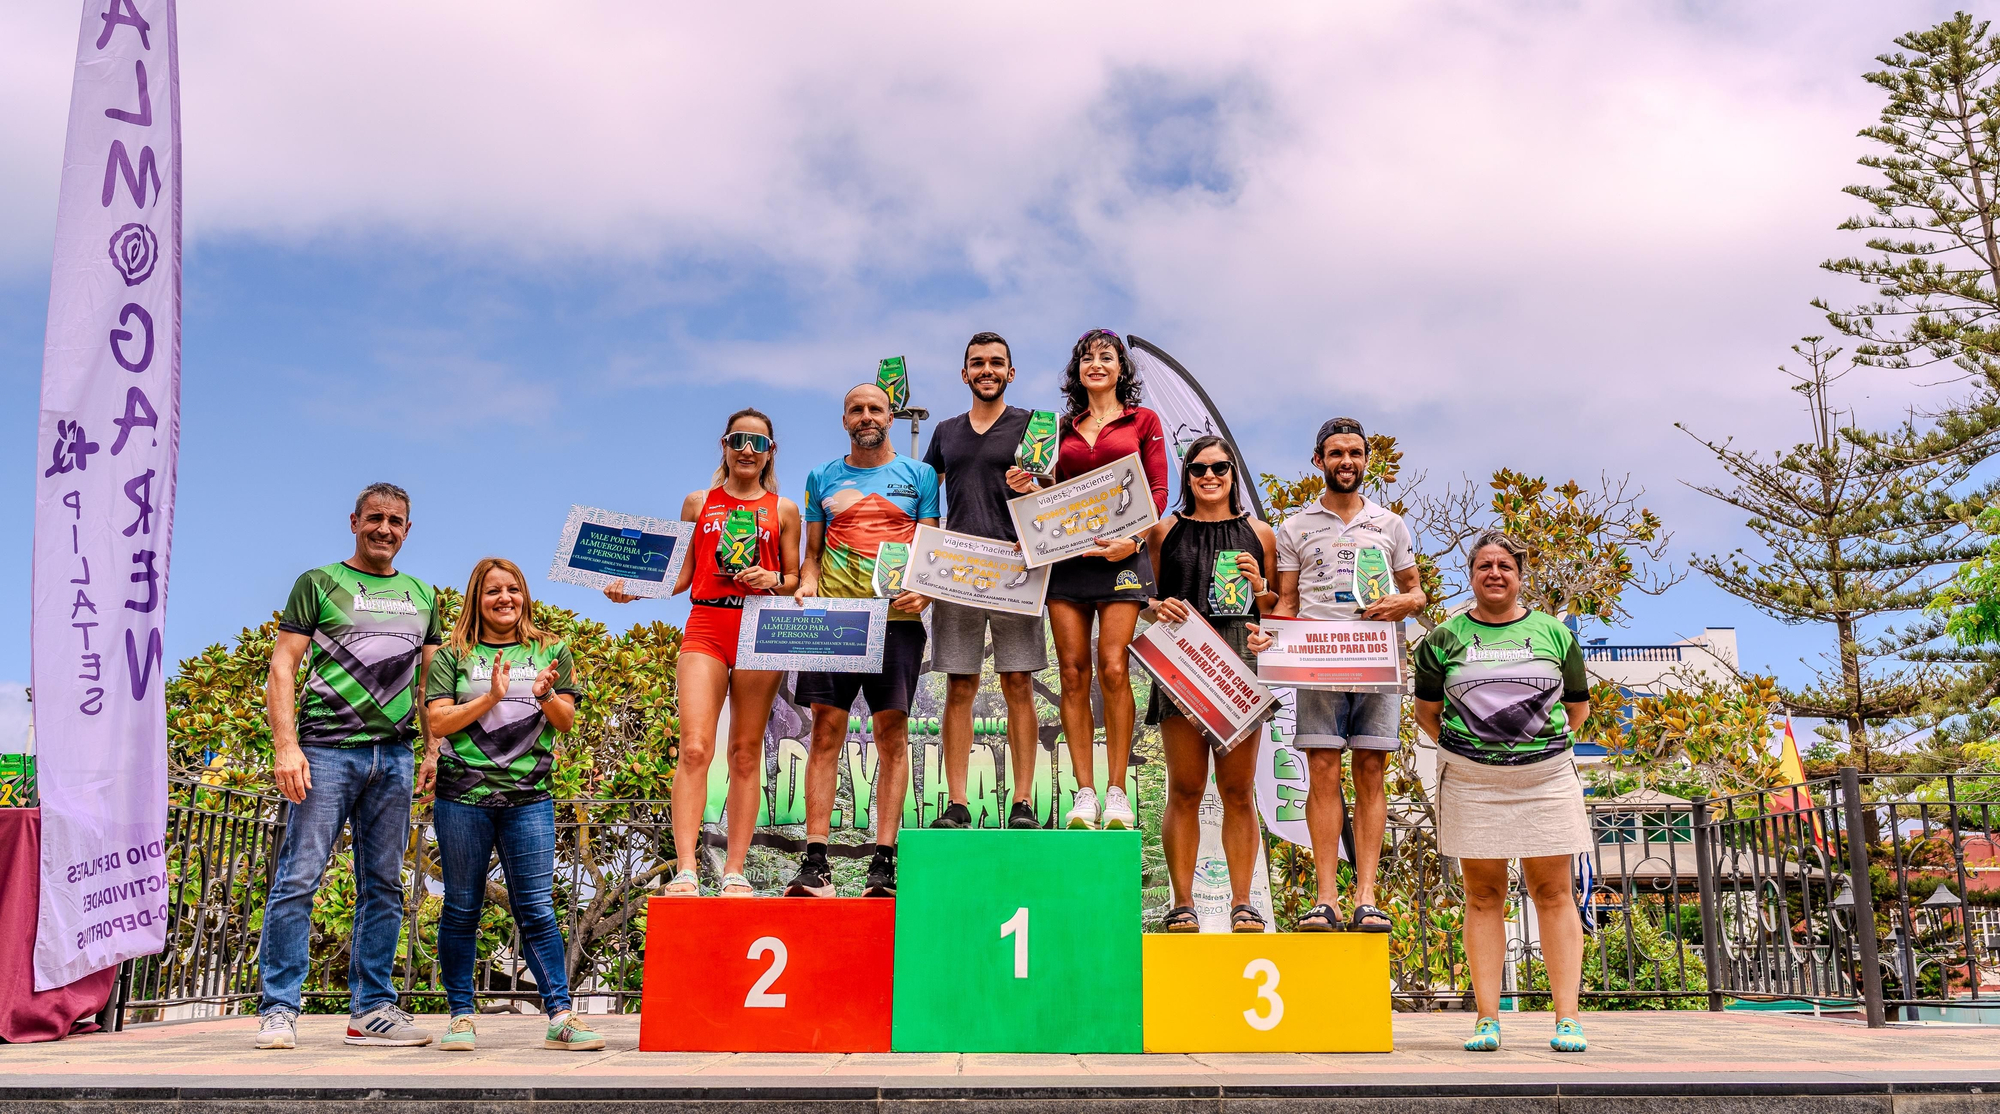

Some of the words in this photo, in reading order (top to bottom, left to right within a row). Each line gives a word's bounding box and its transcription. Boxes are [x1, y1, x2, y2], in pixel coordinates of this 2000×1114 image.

[886, 385, 895, 404] 1
[1032, 442, 1043, 463] 1
[1036, 507, 1067, 522] BONO
[1068, 493, 1109, 512] REGALO
[1110, 485, 1123, 498] DE
[1038, 493, 1062, 505] viajes
[1079, 504, 1108, 520] PARA
[1066, 514, 1109, 536] BILLETES
[580, 538, 622, 552] ALMUERZO
[623, 546, 641, 555] PARA
[590, 532, 609, 542] VALE
[610, 536, 626, 545] POR
[944, 537, 969, 549] viajes
[1040, 544, 1069, 555] CLASIFICADO
[1070, 537, 1093, 547] ABSOLUTO
[592, 549, 631, 561] PERSONAS
[730, 541, 745, 564] 2
[934, 549, 965, 562] BONO
[967, 556, 1008, 571] REGALO
[1010, 563, 1025, 573] DE
[888, 570, 901, 590] 2
[952, 574, 996, 588] BILLETES
[972, 567, 1001, 579] PARA
[1225, 582, 1237, 604] 3
[1368, 578, 1380, 600] 3
[792, 616, 810, 624] POR
[1306, 633, 1328, 643] VALE
[1331, 632, 1350, 642] POR
[1352, 632, 1378, 642] CENA
[1380, 630, 1387, 641] Ó
[1287, 644, 1338, 654] ALMUERZO
[1340, 644, 1366, 654] PARA
[1367, 643, 1388, 653] DOS
[1176, 638, 1216, 678] ALMUERZO
[1213, 676, 1235, 698] PARA
[1231, 695, 1252, 715] DOS
[1199, 642, 1220, 665] VALE
[1216, 659, 1236, 680] POR
[1231, 675, 1251, 700] CENA
[1251, 694, 1261, 706] Ó
[0, 783, 13, 806] 2
[1000, 907, 1030, 979] 1
[743, 936, 789, 1008] 2
[1242, 958, 1286, 1032] 3
